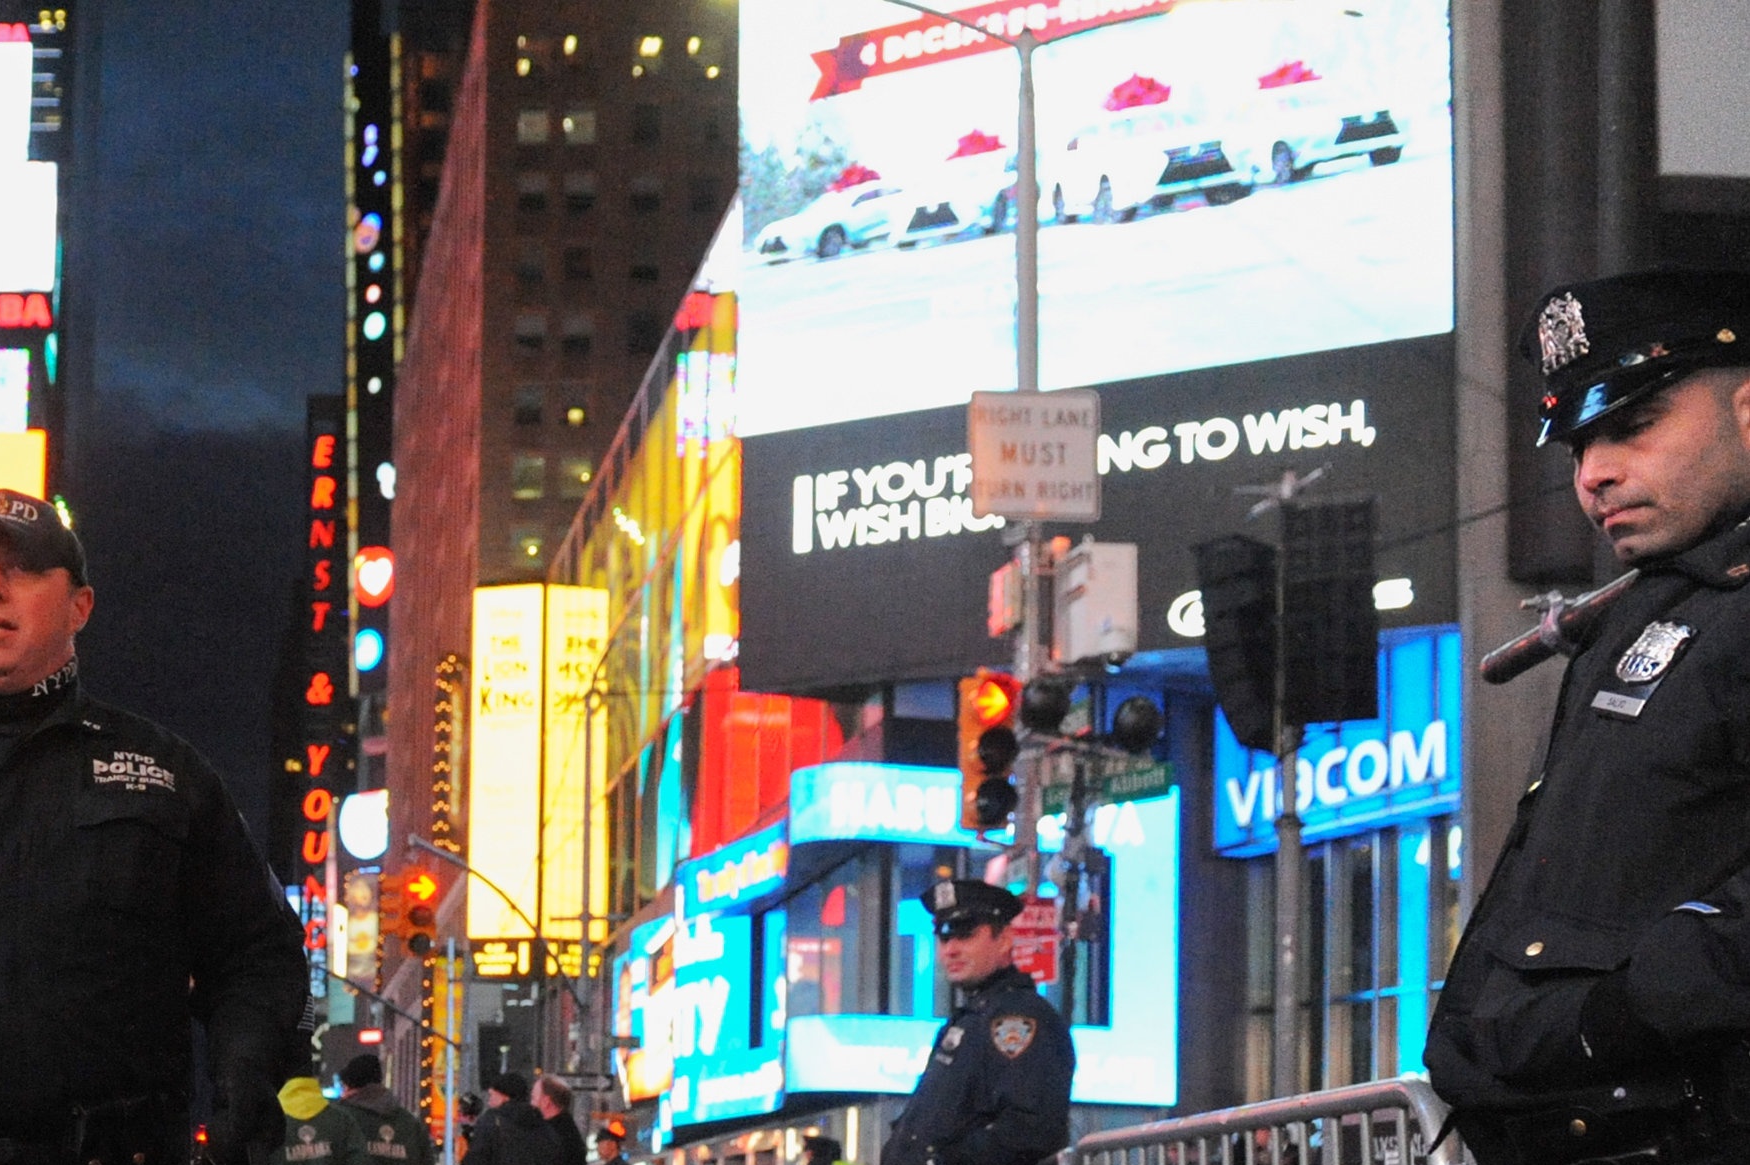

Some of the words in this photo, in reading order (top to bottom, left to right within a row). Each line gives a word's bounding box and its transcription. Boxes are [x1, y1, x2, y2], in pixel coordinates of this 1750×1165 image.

[976, 406, 1032, 426] RIGHT
[1040, 408, 1091, 428] LANE
[815, 470, 850, 512] IF
[1097, 427, 1172, 475] NG
[1173, 417, 1240, 464] TO
[1242, 400, 1377, 454] WISH,
[1001, 442, 1066, 466] MUST
[1036, 480, 1095, 500] RIGHT
[309, 434, 337, 634] ERNST
[816, 501, 921, 550] WISH
[305, 671, 335, 705] &
[479, 686, 534, 716] KING
[92, 759, 175, 786] POLICE
[113, 751, 155, 764] NYPD
[1225, 718, 1446, 828] VICOM
[302, 744, 332, 950] YOUNG
